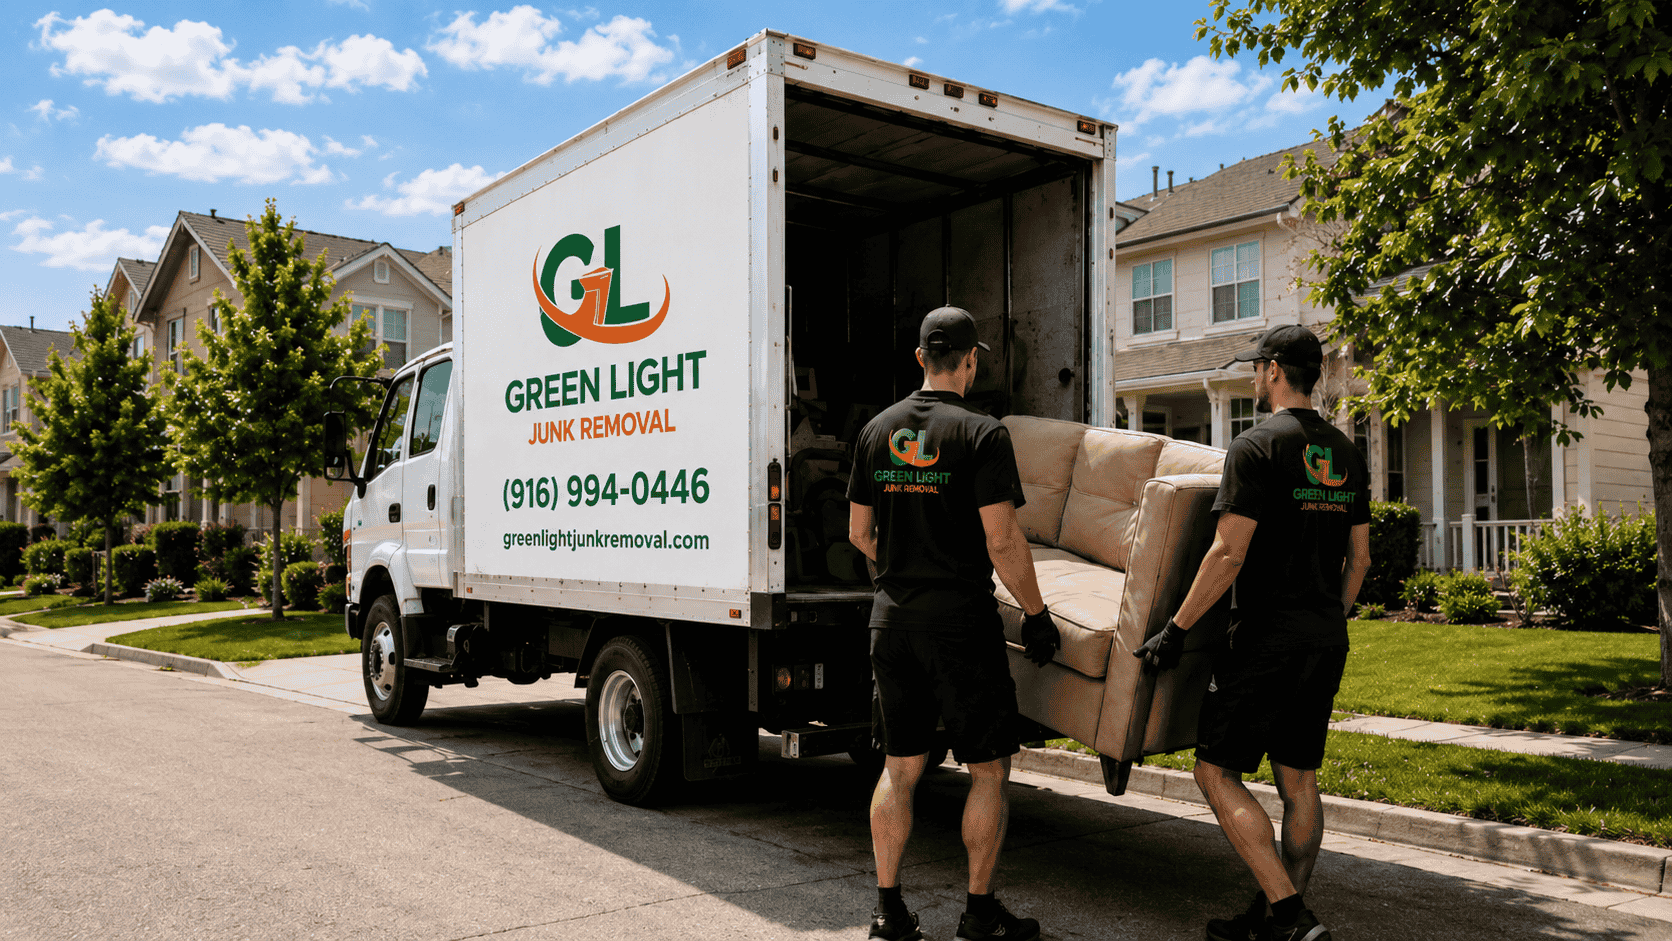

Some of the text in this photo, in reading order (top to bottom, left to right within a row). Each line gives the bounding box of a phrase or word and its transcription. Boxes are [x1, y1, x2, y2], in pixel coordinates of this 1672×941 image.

[504, 350, 707, 413] GREEN LIGHT
[528, 409, 676, 445] JUNK REMOVAL
[874, 470, 951, 484] GREEN LIGHT
[503, 467, 710, 511] (916) 994-0446
[884, 484, 939, 494] JUNK REMOVAL
[1293, 488, 1356, 502] GREEN LIGHT
[503, 529, 710, 551] greenlightjunkremoval.com
